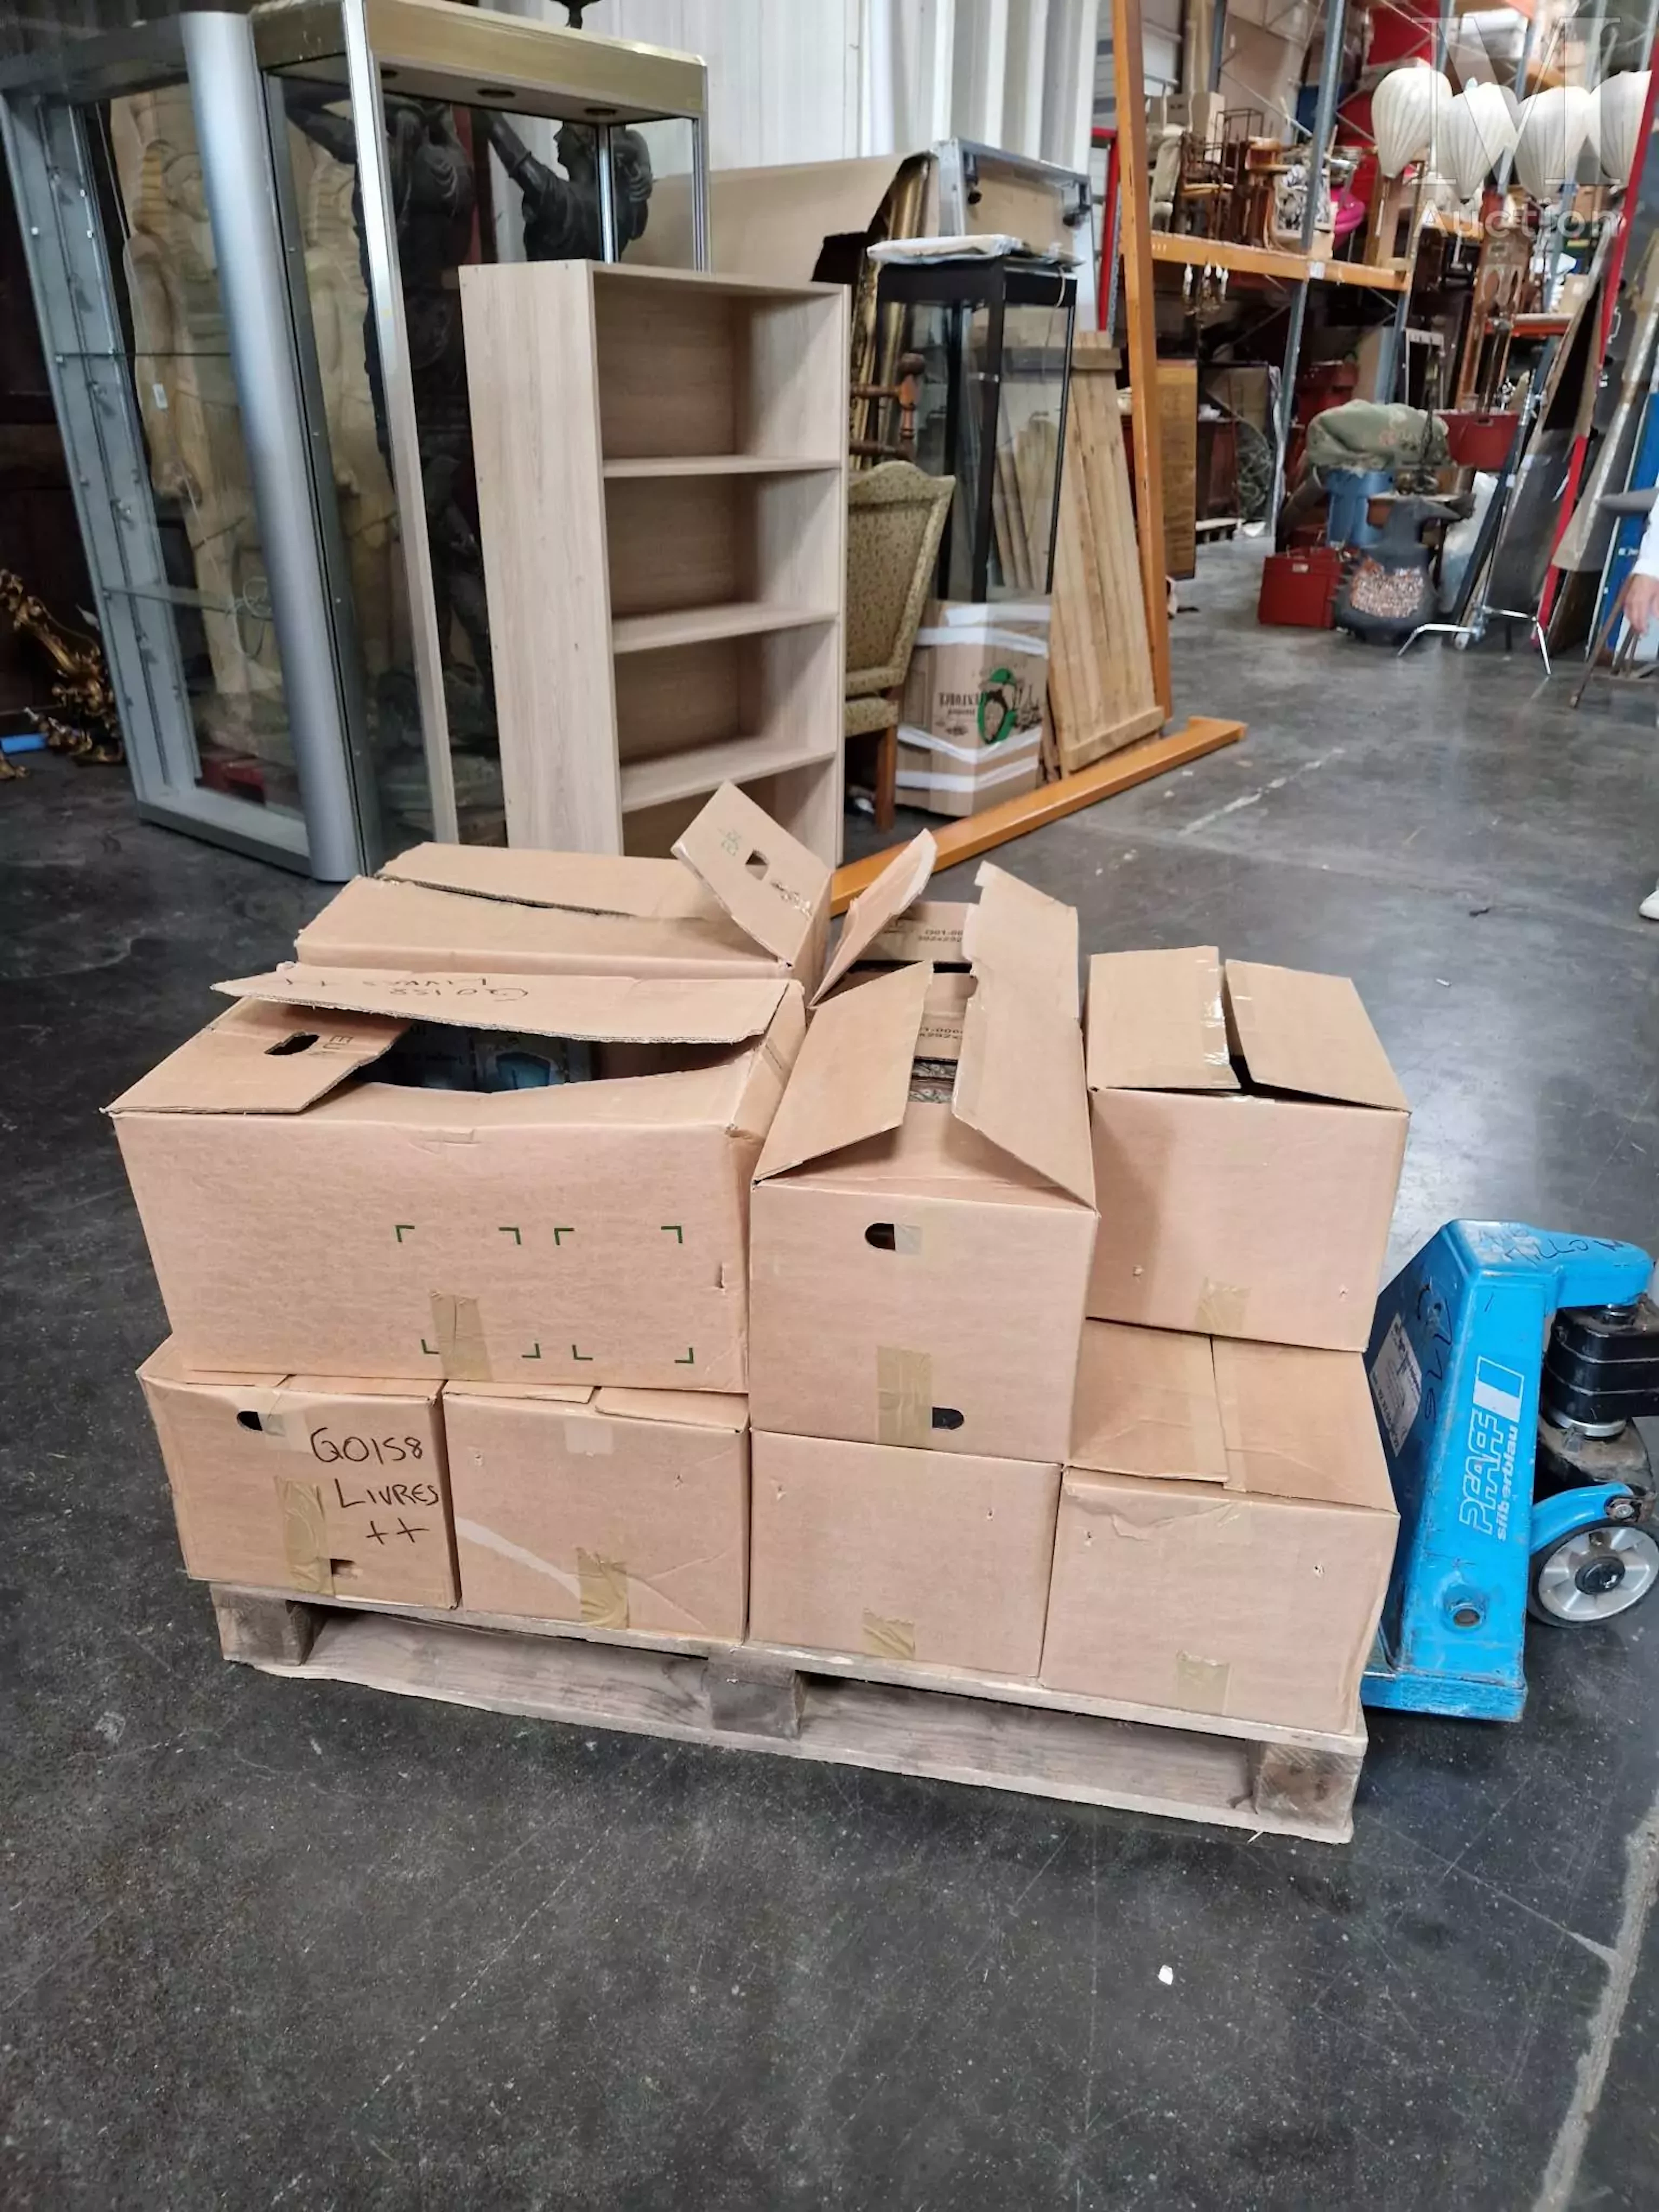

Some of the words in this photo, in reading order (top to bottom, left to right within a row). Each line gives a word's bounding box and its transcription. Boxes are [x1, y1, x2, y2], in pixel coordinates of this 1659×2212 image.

[334, 1478, 439, 1508] LIVRES
[1459, 1407, 1504, 1535] PFAFF
[1495, 1425, 1518, 1541] silberblau
